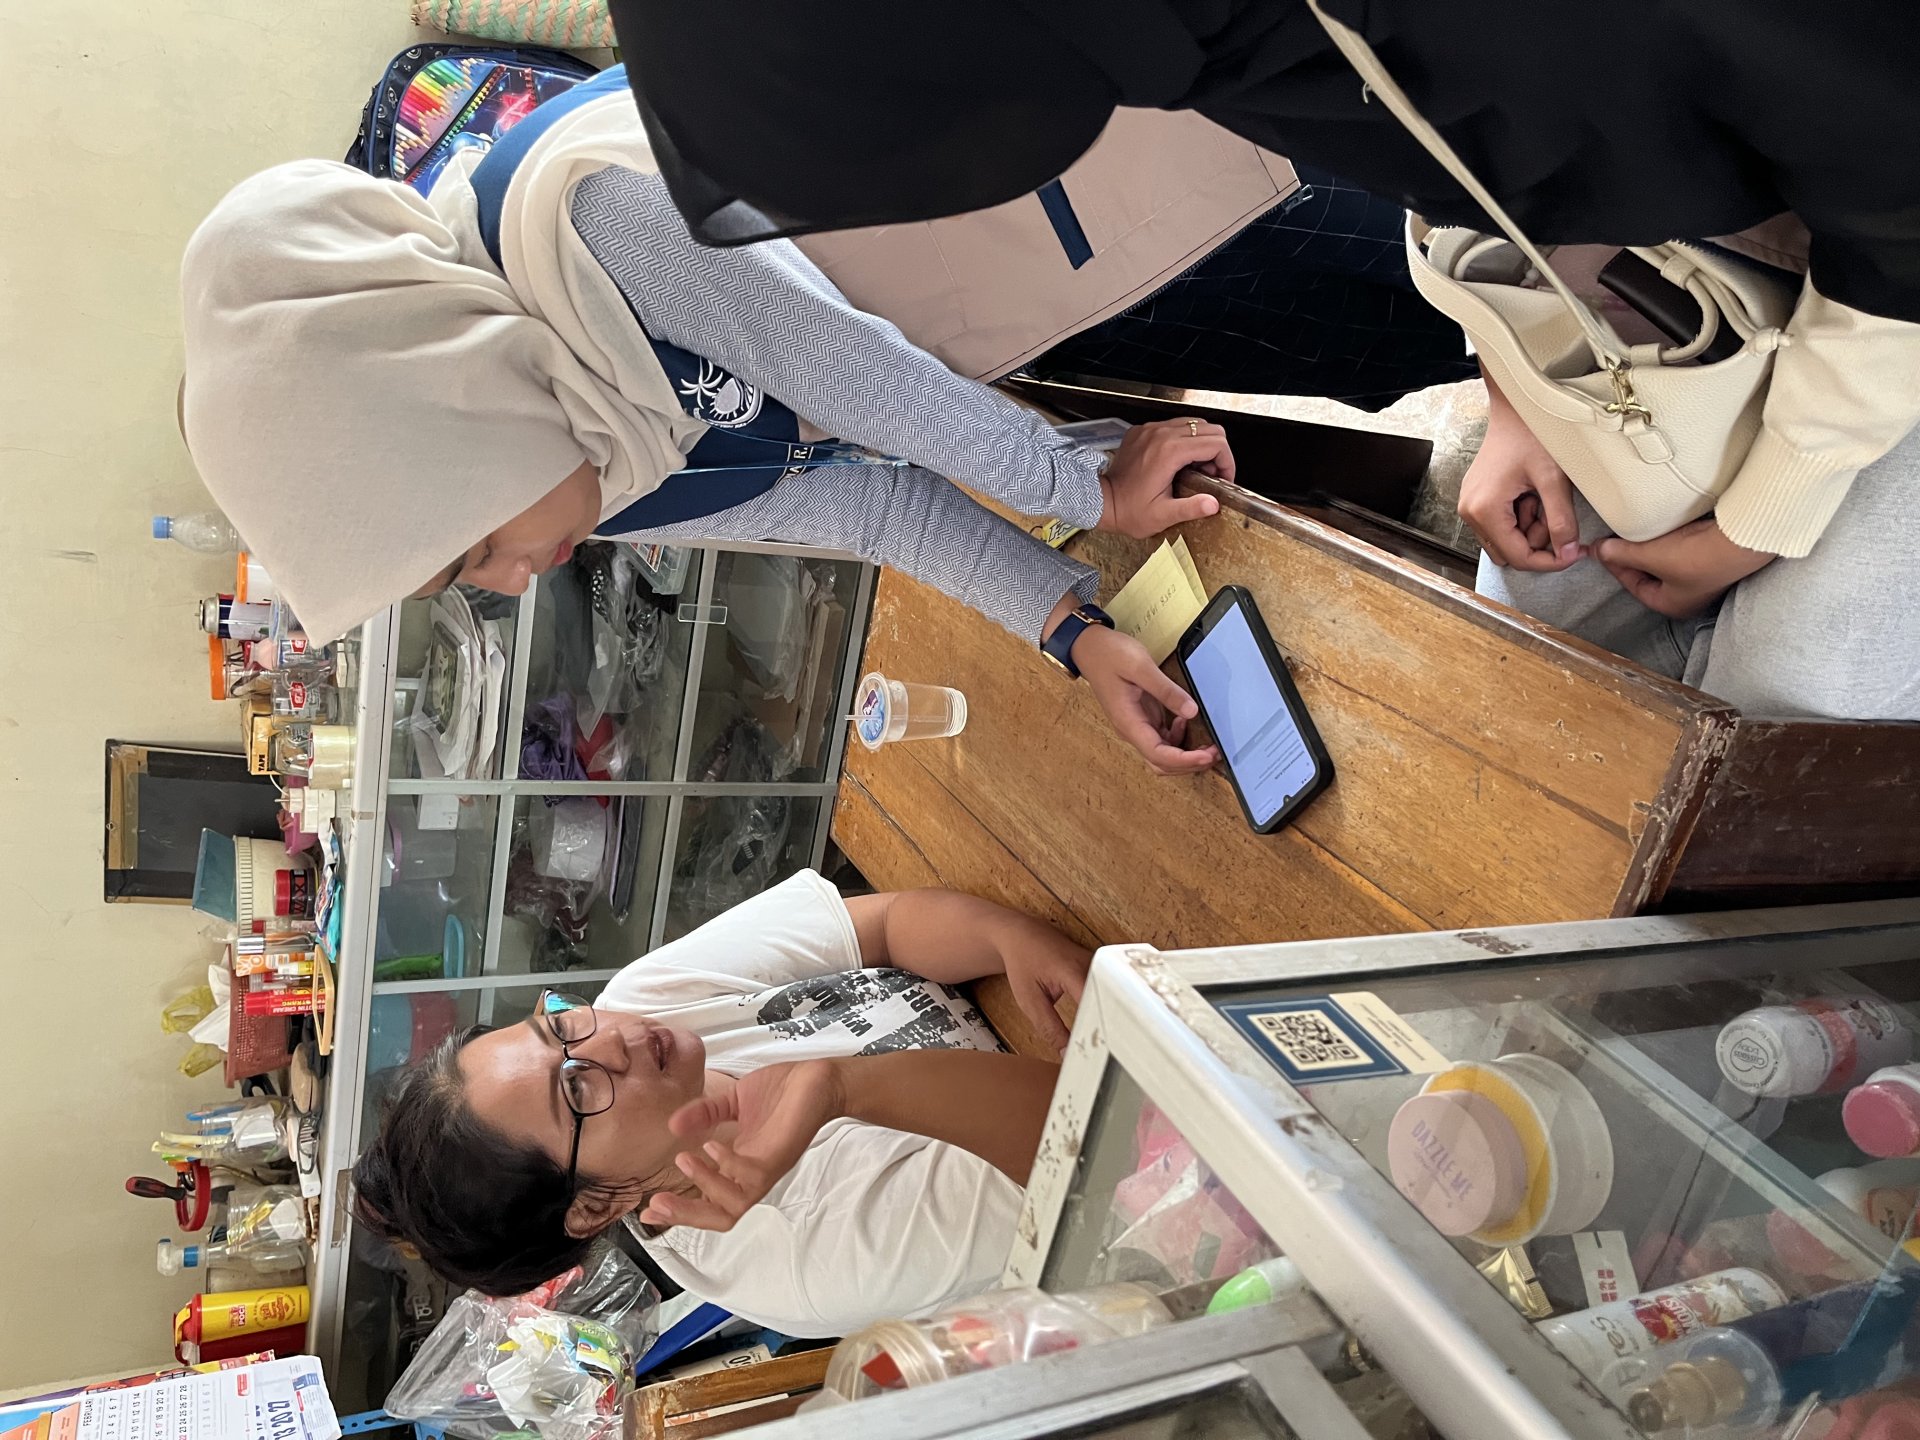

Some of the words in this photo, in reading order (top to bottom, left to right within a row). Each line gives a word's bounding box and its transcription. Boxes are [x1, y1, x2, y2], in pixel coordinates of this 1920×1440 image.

[294, 883, 305, 914] WAX
[810, 986, 841, 1011] DO
[1411, 1120, 1456, 1178] DAZZLE
[1451, 1170, 1473, 1201] ME
[83, 1398, 94, 1426] FEBRUARI
[268, 1401, 290, 1412] 27
[270, 1412, 293, 1427] 20
